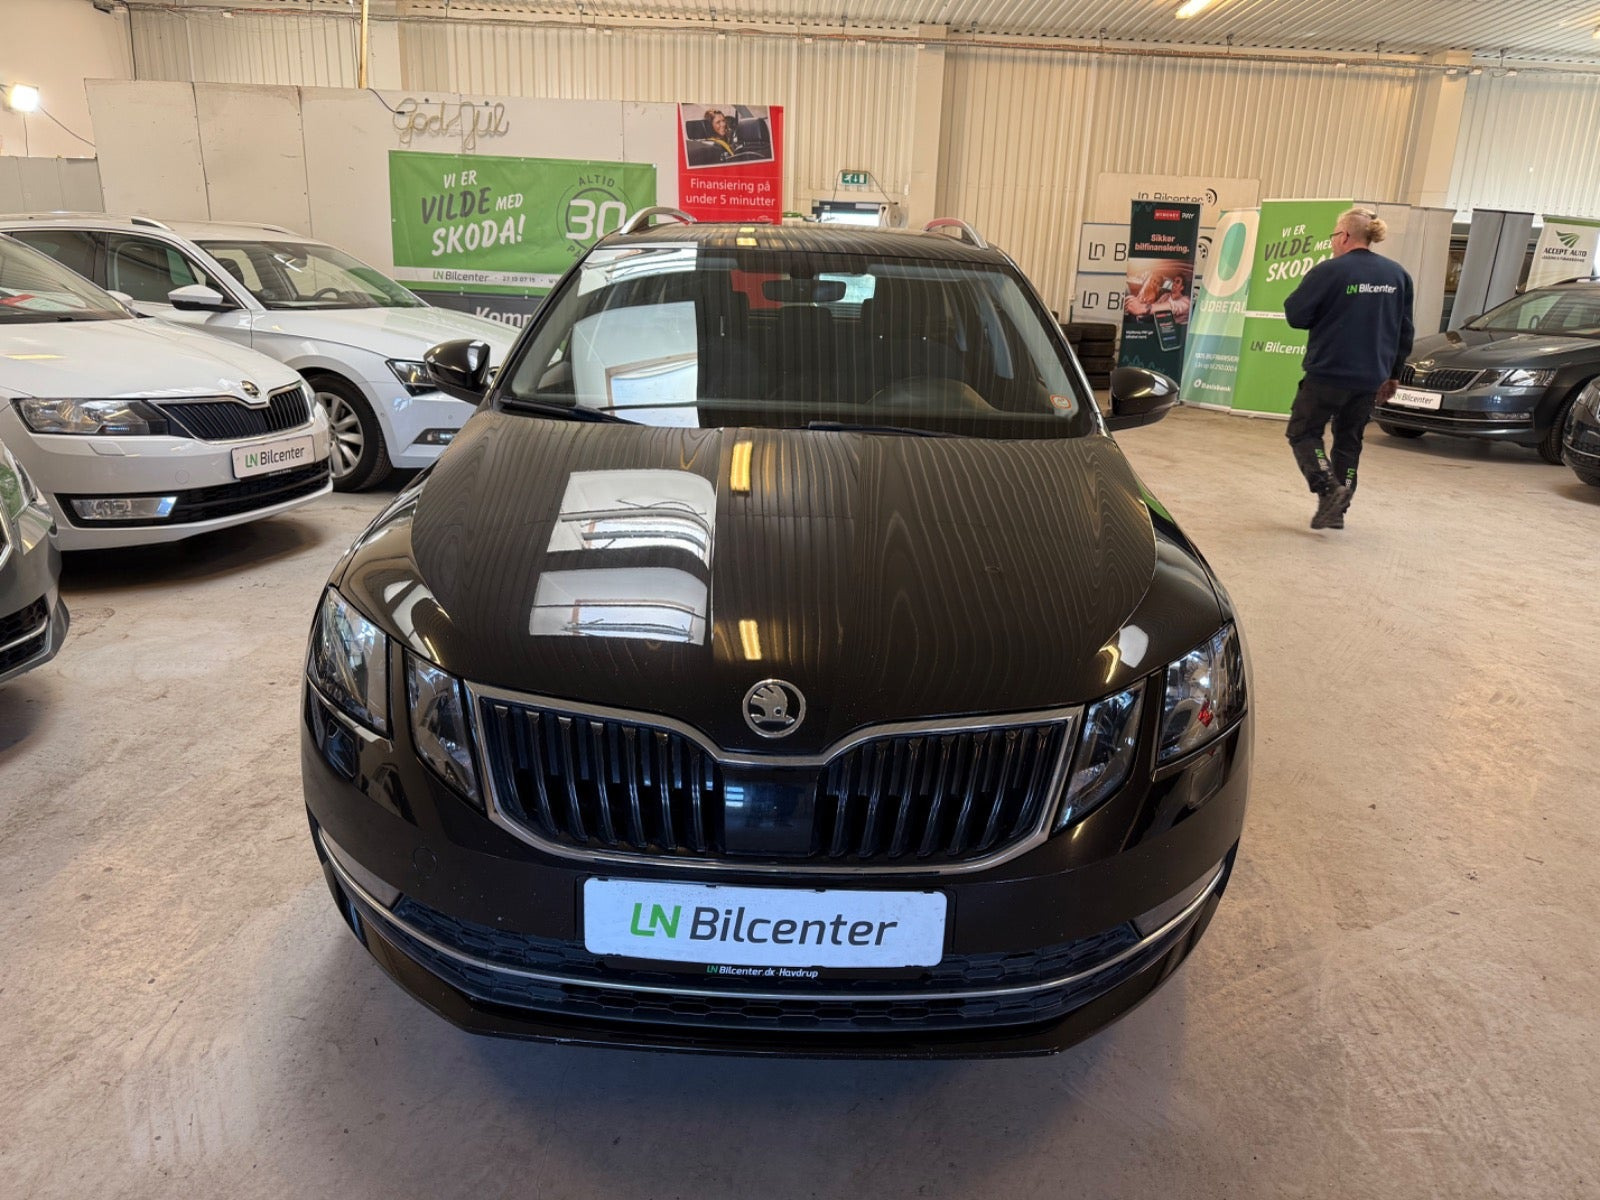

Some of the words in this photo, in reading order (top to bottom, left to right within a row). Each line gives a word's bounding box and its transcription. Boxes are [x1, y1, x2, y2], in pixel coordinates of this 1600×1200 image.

[443, 172, 457, 190] VI
[460, 169, 478, 187] ER
[578, 174, 616, 188] ALTID
[689, 177, 755, 194] Finansiering
[757, 180, 772, 194] på
[421, 186, 492, 225] VILDE
[495, 193, 524, 212] MED
[685, 193, 718, 205] under
[719, 194, 728, 205] 5
[729, 194, 777, 207] minutter
[565, 198, 628, 241] 30
[431, 214, 527, 257] SKODA!
[1150, 233, 1176, 243] Sikker
[1282, 227, 1292, 238] VI
[1293, 224, 1307, 236] ER
[1264, 235, 1315, 262] VILDE
[432, 270, 444, 281] LN
[445, 270, 490, 283] Bilcenter
[1346, 284, 1358, 295] LN
[1359, 282, 1398, 294] Bilcenter
[1200, 300, 1247, 313] UDBETAL
[1250, 340, 1265, 352] LN
[1264, 341, 1307, 356] Bilcent
[245, 453, 259, 469] LN
[260, 446, 305, 466] Bilcenter
[630, 902, 682, 939] LN
[689, 905, 899, 947] Bilcenter
[706, 964, 719, 974] LN
[778, 967, 819, 979] Havdrup
